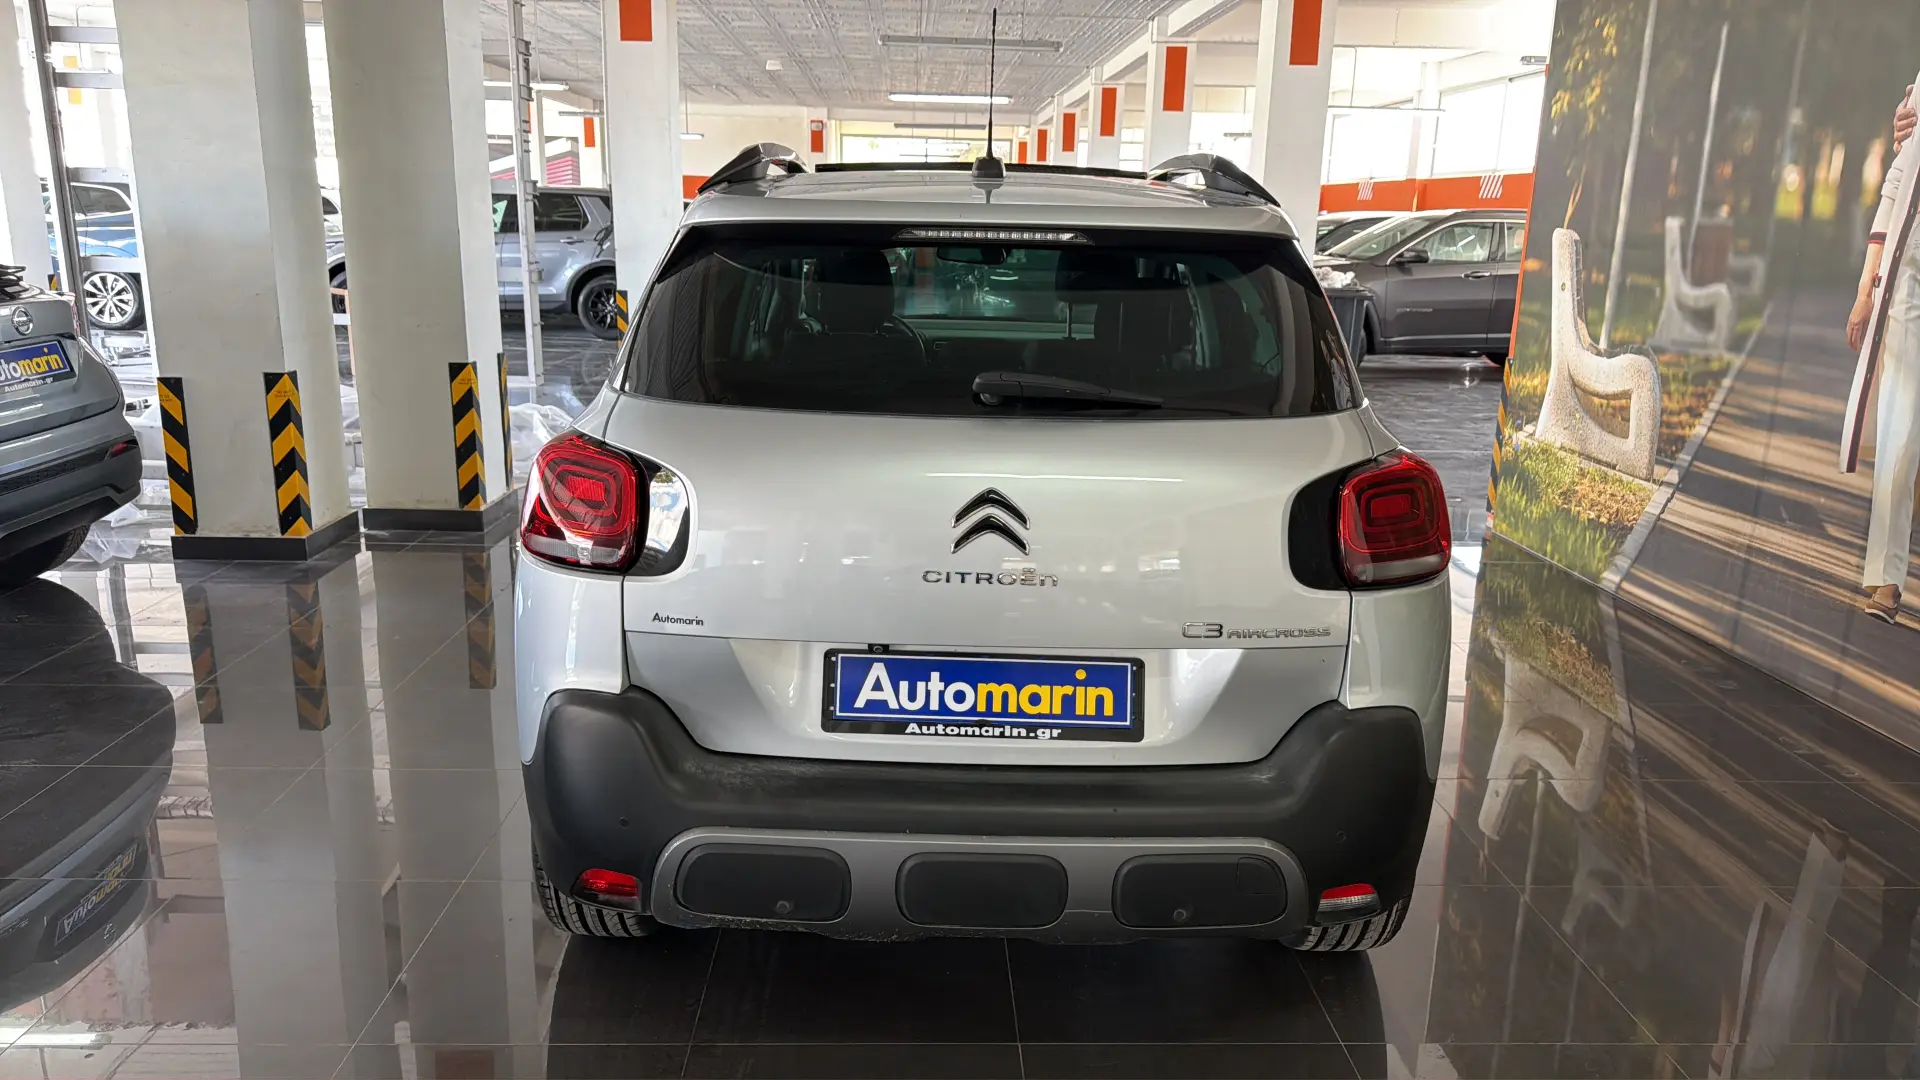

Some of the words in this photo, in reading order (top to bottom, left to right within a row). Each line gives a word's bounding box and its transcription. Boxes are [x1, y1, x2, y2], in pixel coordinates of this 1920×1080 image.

[0, 347, 64, 380] utomarin
[5, 377, 54, 393] Automarin.gr
[652, 612, 704, 626] Automarin
[1182, 621, 1224, 639] C3
[1227, 627, 1332, 639] AIRCROSS
[853, 662, 1114, 717] Automarin
[905, 722, 1062, 739] Automarin.gr
